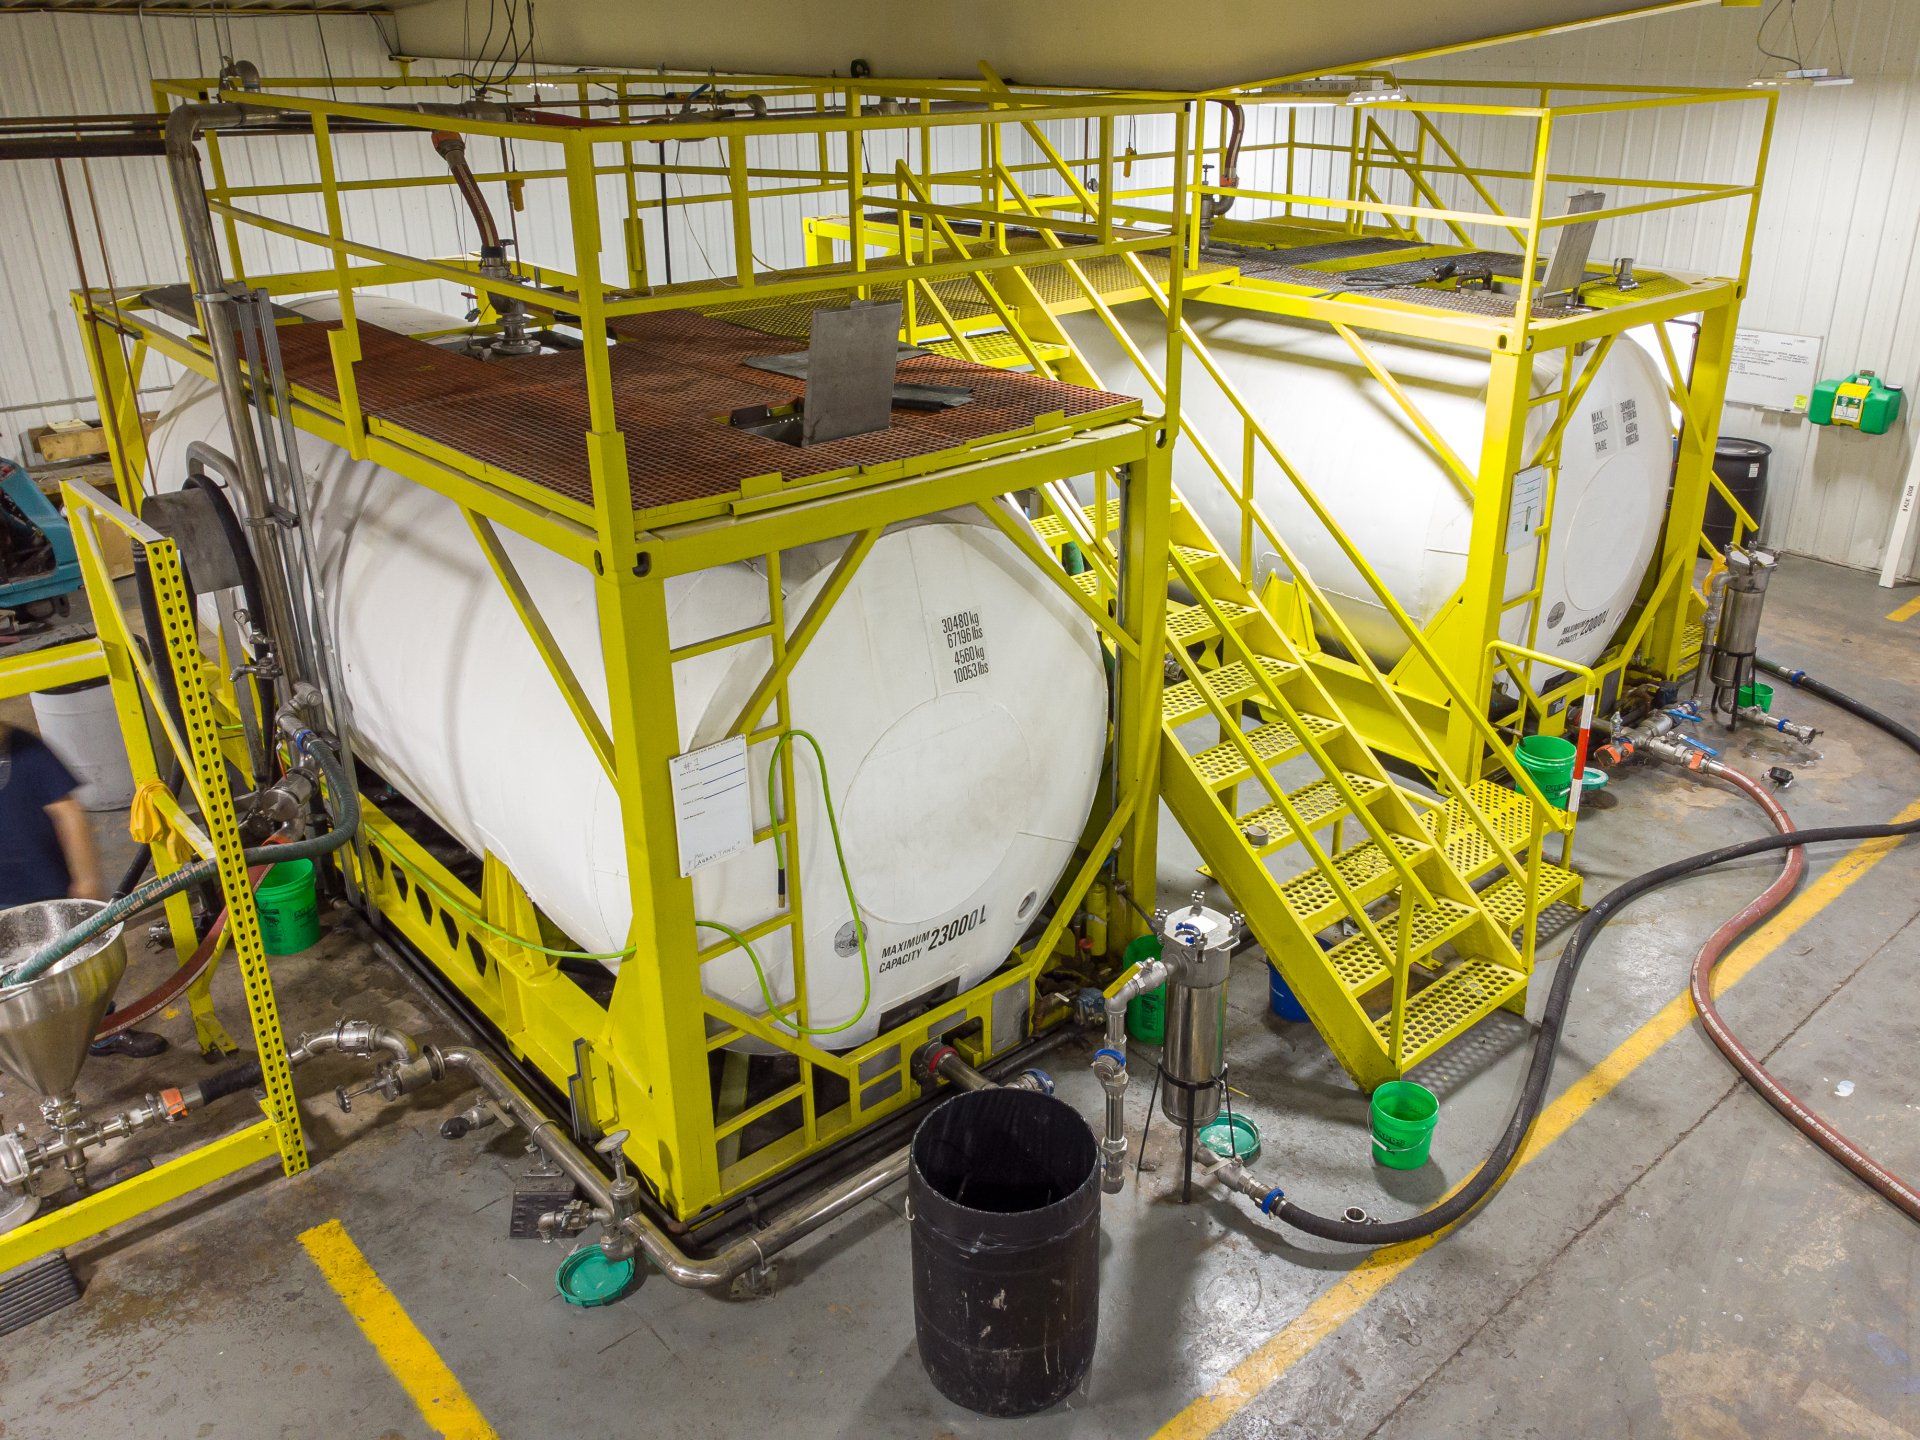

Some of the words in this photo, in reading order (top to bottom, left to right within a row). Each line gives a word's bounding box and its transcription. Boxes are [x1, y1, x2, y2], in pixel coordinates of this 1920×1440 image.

[881, 930, 931, 959] MAXIMUM
[927, 908, 979, 951] 23000
[979, 904, 987, 925] L
[879, 947, 923, 974] CAPACITY
